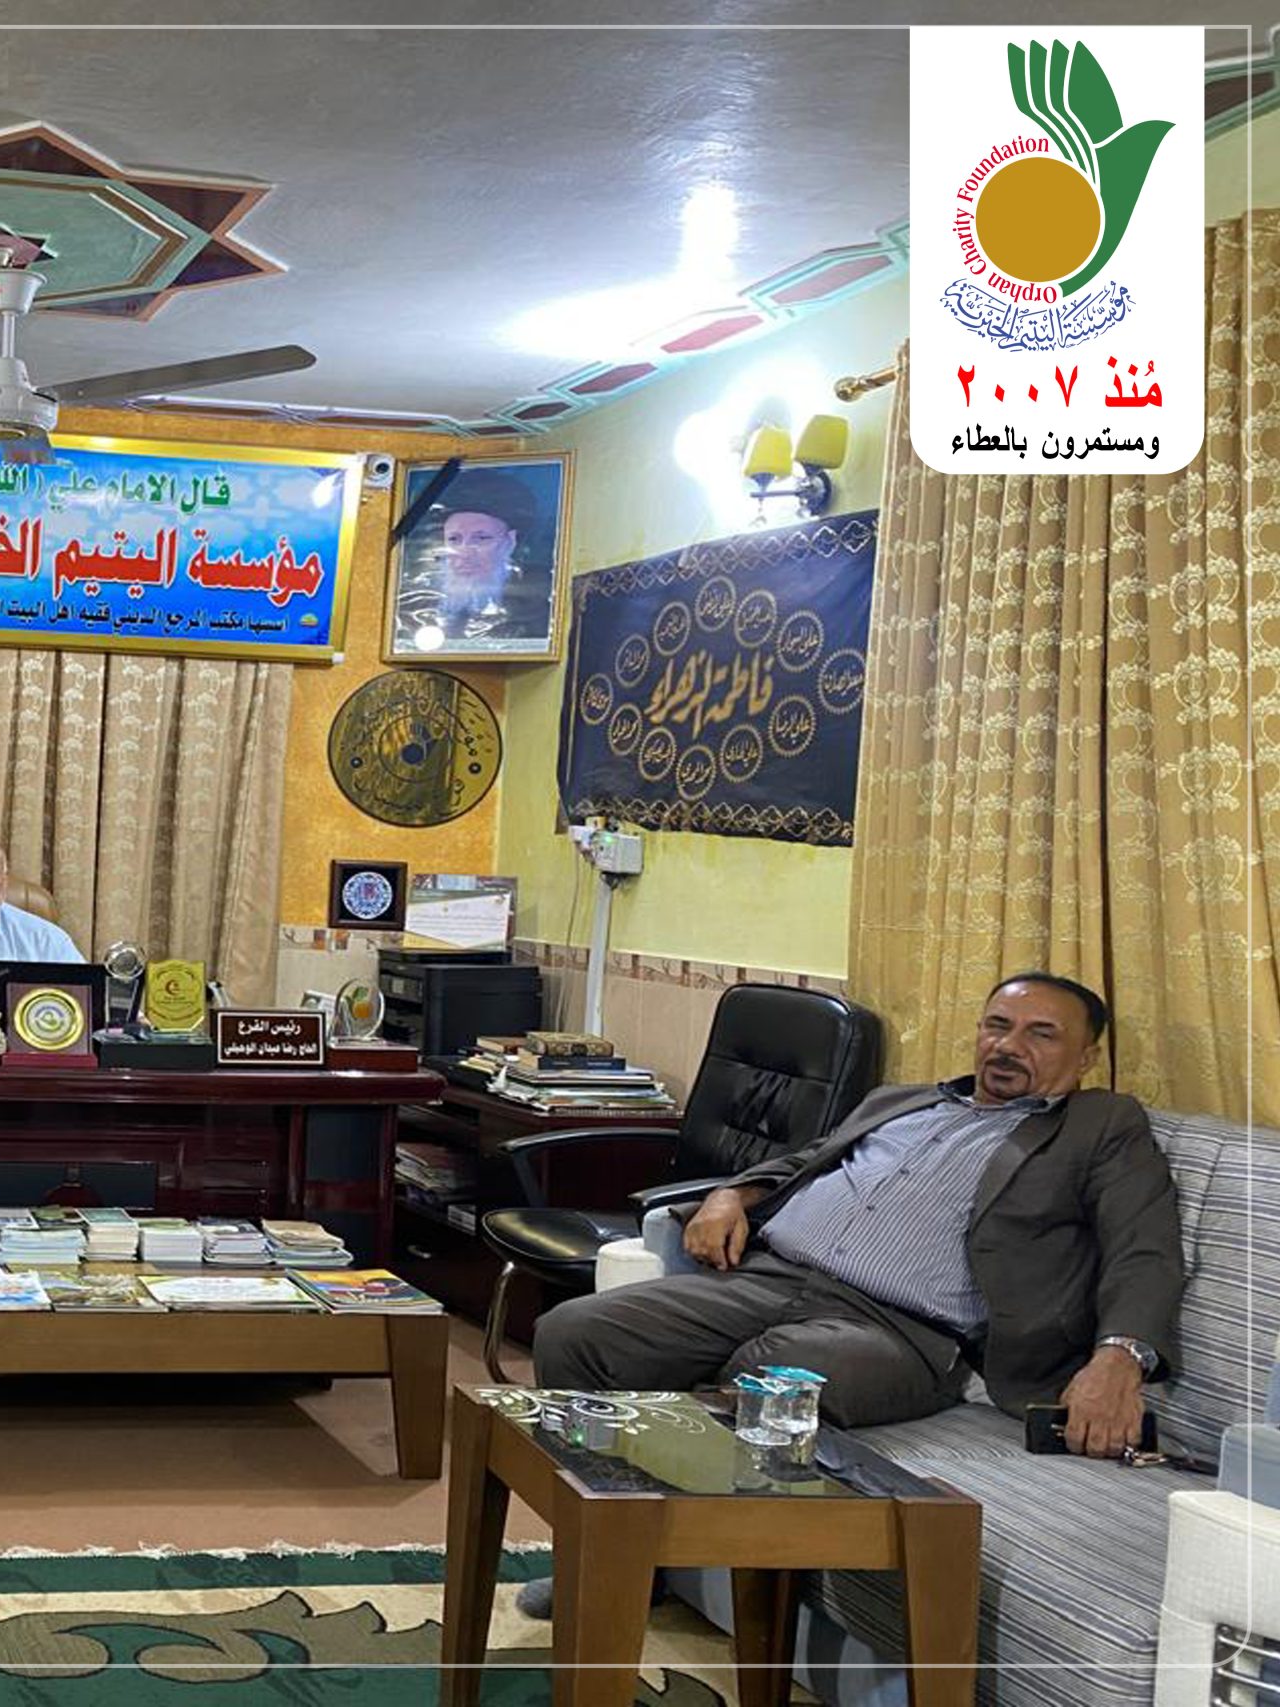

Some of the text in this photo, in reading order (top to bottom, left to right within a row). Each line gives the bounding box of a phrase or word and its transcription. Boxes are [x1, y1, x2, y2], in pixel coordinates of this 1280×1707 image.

[180, 469, 232, 514] قال
[53, 527, 177, 600] اليتيم
[187, 529, 324, 607] مؤسسة
[238, 1019, 302, 1036] رئيس الفرع
